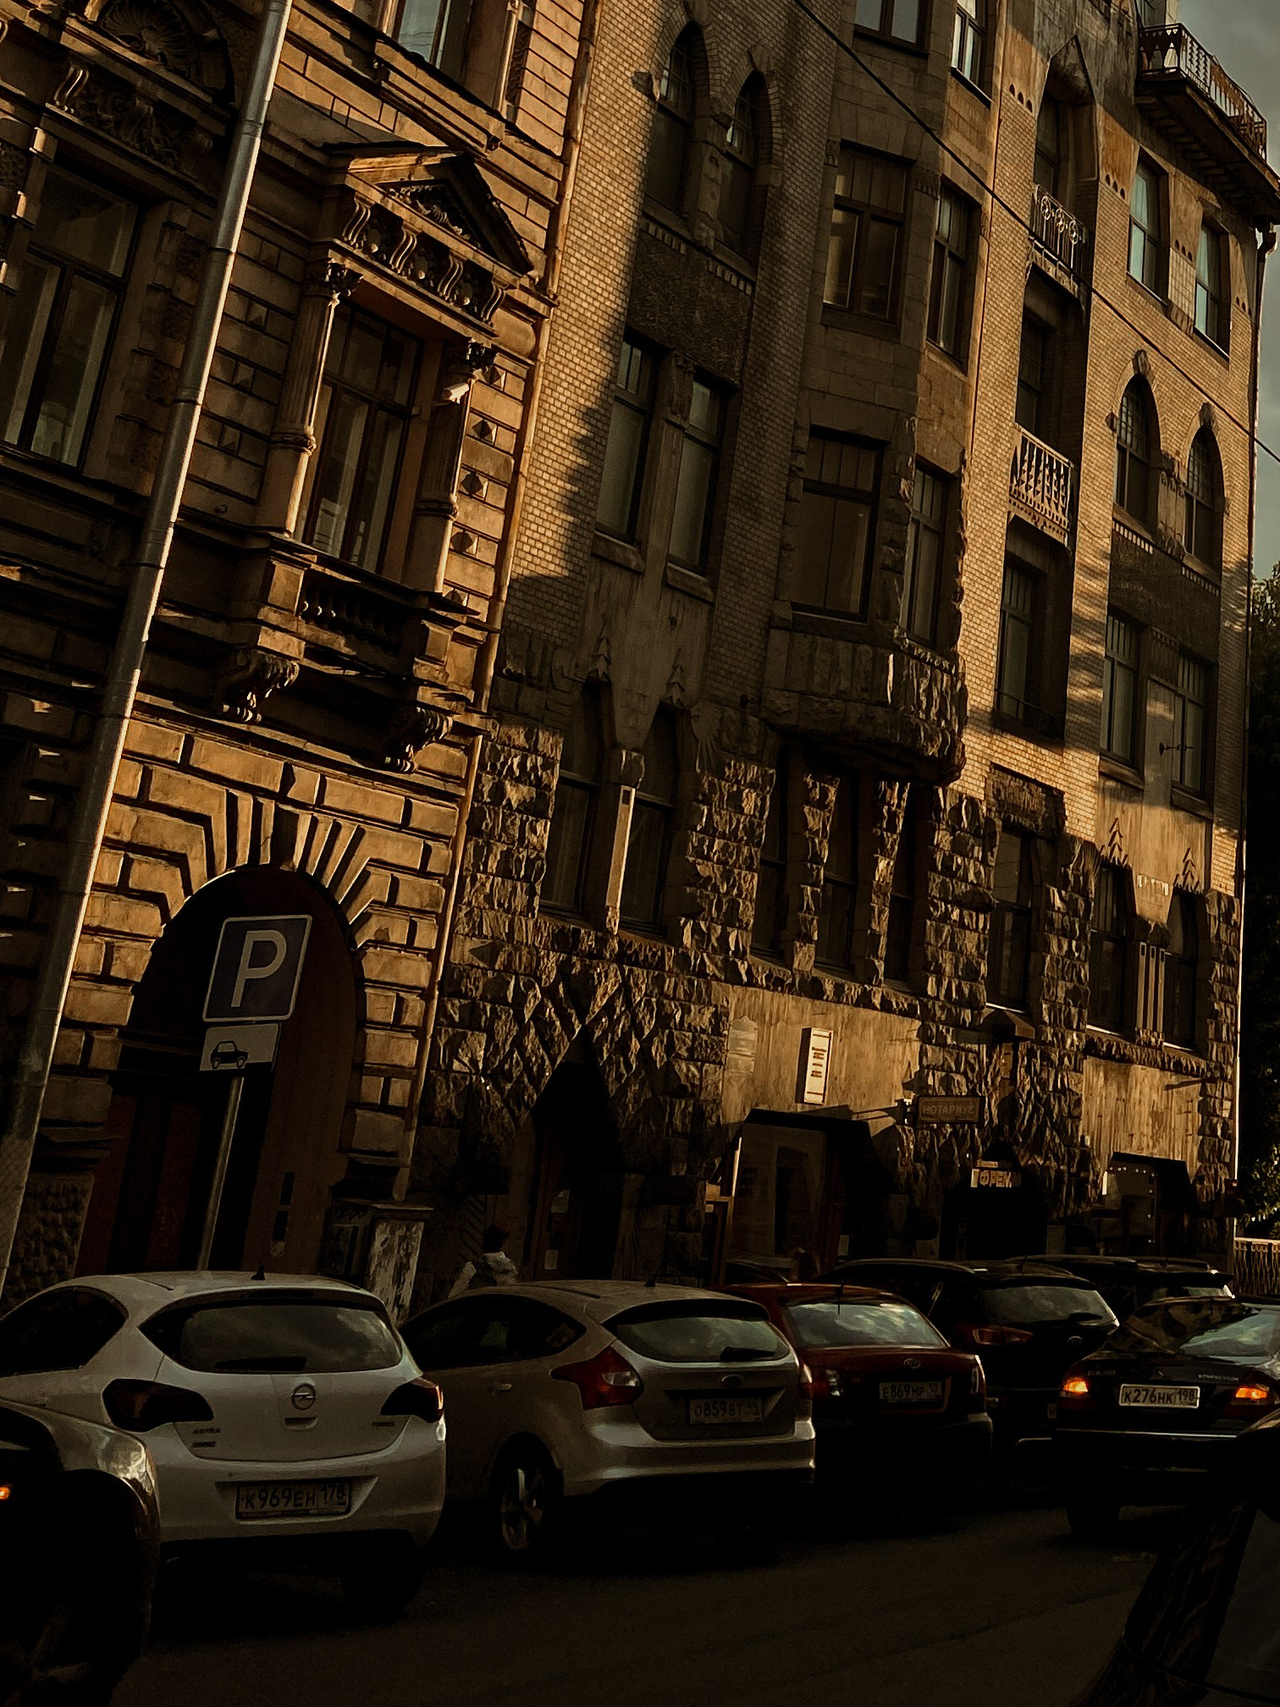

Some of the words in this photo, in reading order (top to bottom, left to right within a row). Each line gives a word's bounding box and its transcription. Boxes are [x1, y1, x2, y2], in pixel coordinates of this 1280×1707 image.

[231, 929, 287, 1007] P
[1124, 1390, 1173, 1404] К276НК
[1178, 1389, 1195, 1401] 198
[244, 1488, 316, 1510] К969ЕН
[321, 1483, 346, 1499] 178
